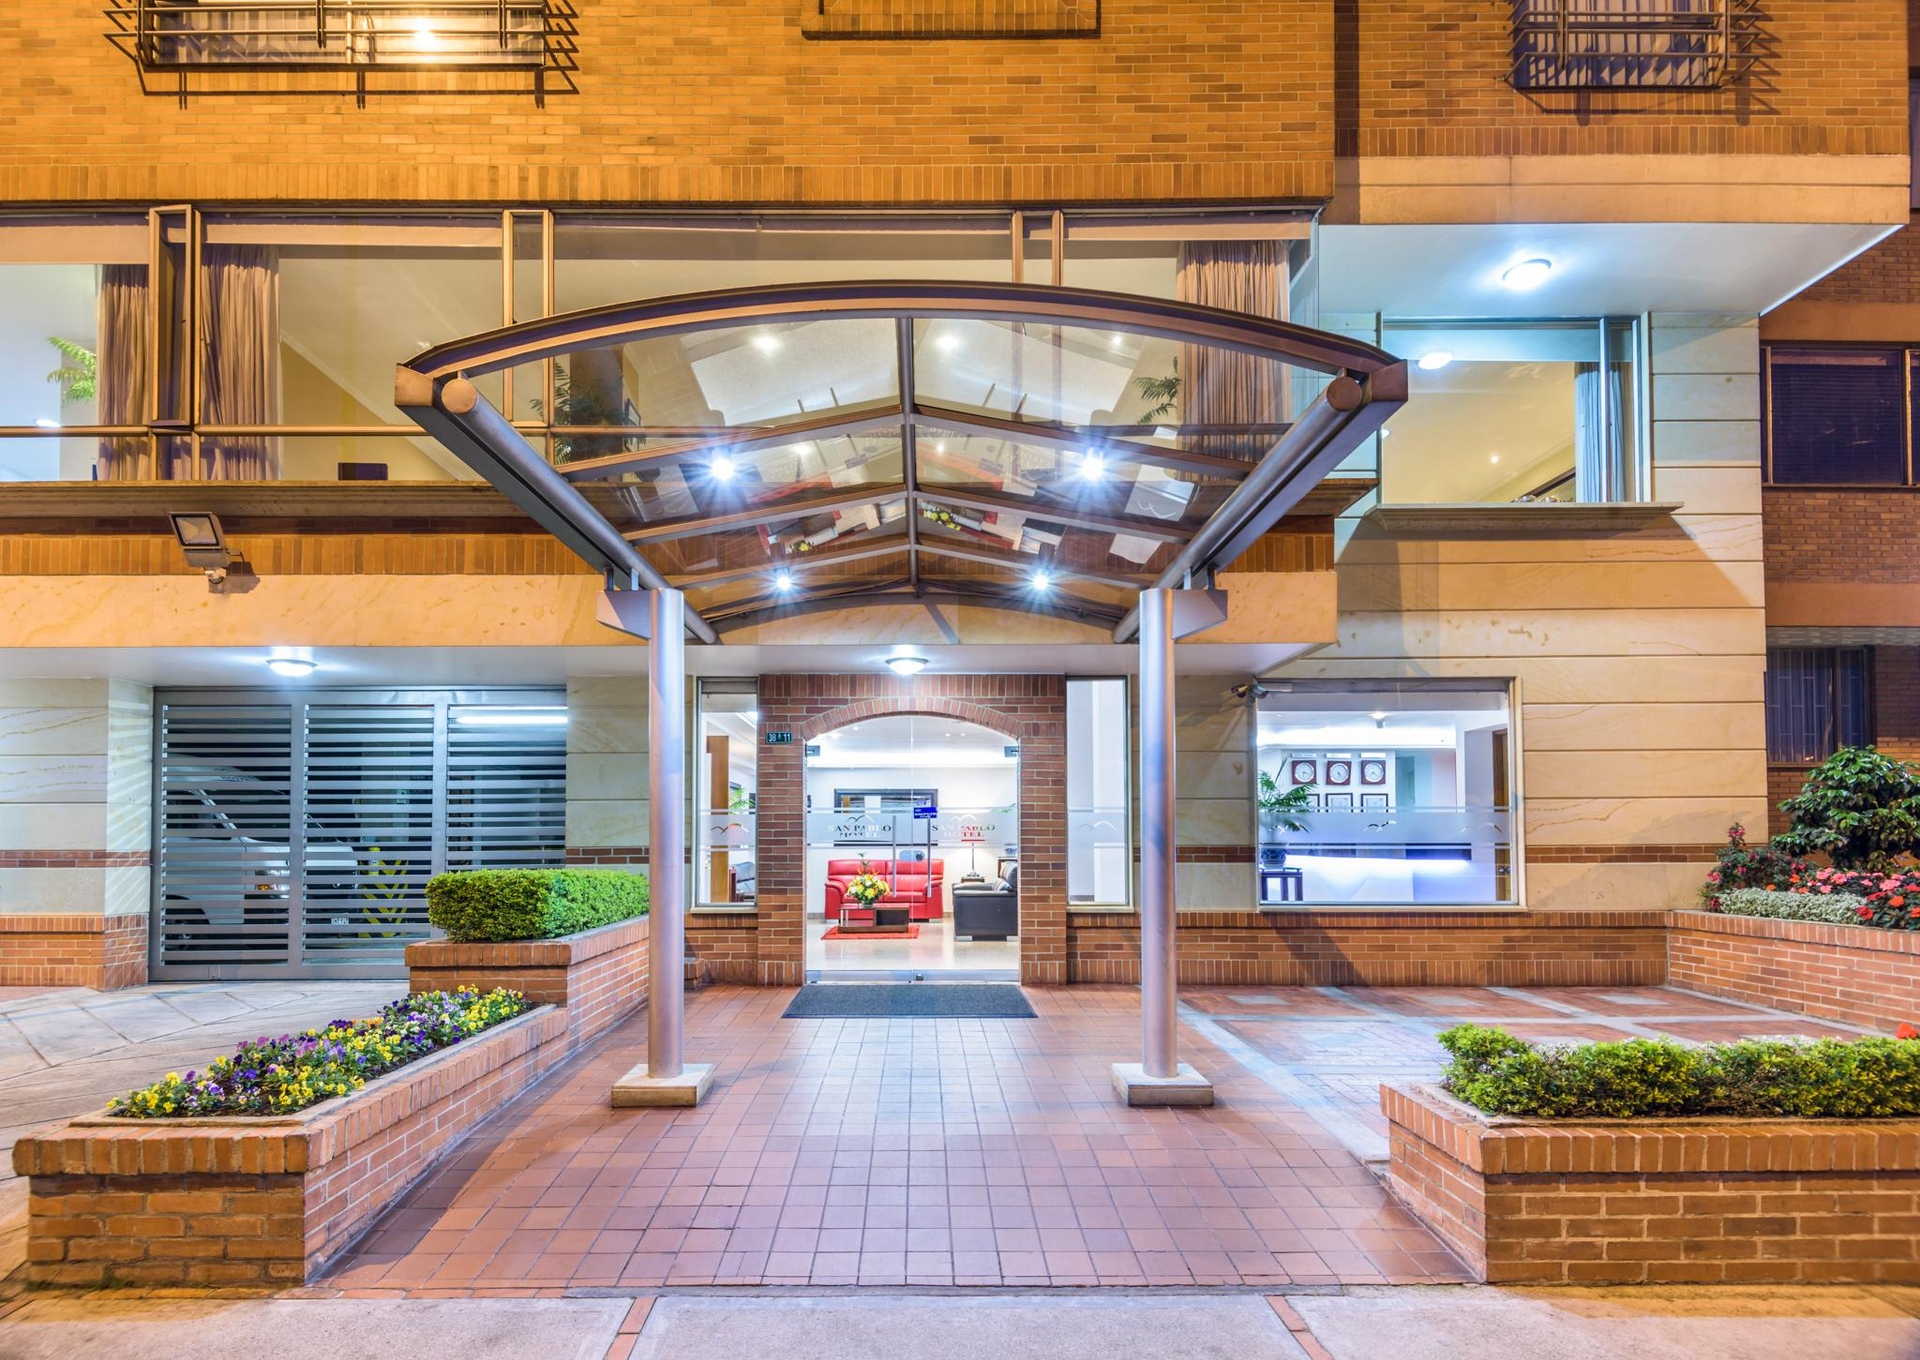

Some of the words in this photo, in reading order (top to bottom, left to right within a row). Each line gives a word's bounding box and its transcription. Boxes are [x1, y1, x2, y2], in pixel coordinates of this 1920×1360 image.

[768, 733, 777, 742] 38
[782, 733, 791, 742] 11
[827, 824, 850, 832] SAN
[854, 824, 892, 832] PABLO
[932, 824, 955, 832] SAN
[959, 824, 996, 832] PABLO
